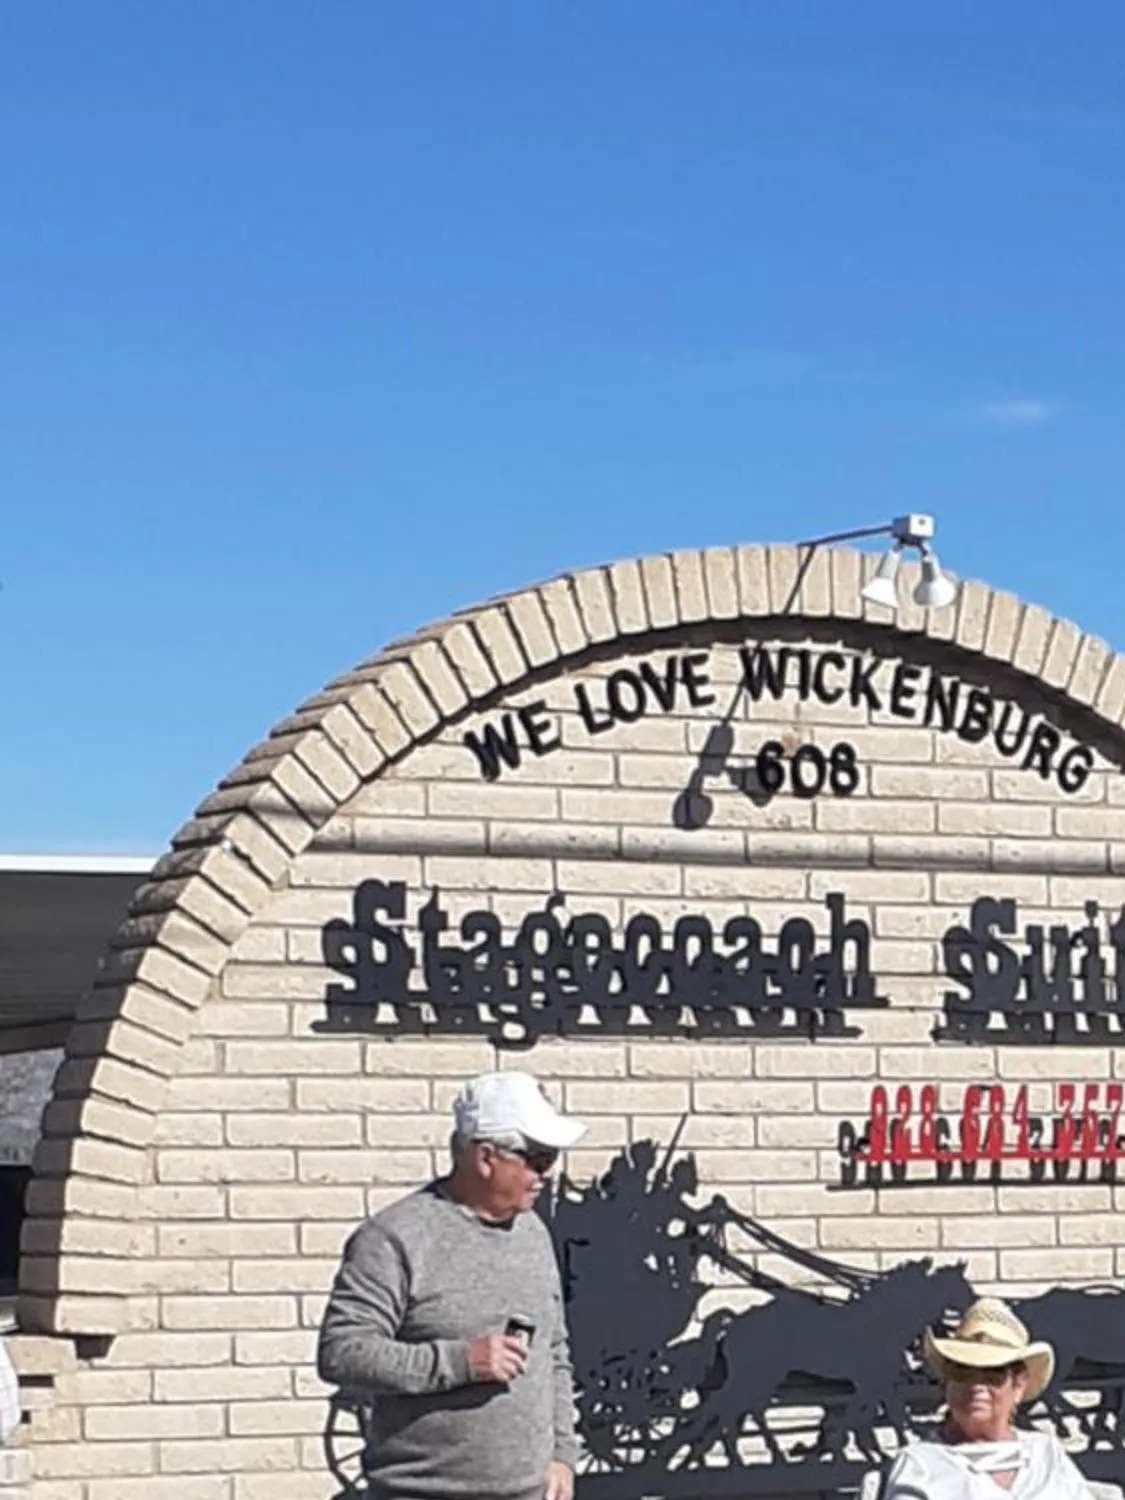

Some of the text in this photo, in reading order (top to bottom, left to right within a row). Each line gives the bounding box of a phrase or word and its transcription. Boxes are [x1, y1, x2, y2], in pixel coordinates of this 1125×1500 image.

[463, 648, 1094, 794] WE LOVE WICKENBURG
[756, 741, 859, 798] 608
[345, 879, 874, 1038] Stagecoach
